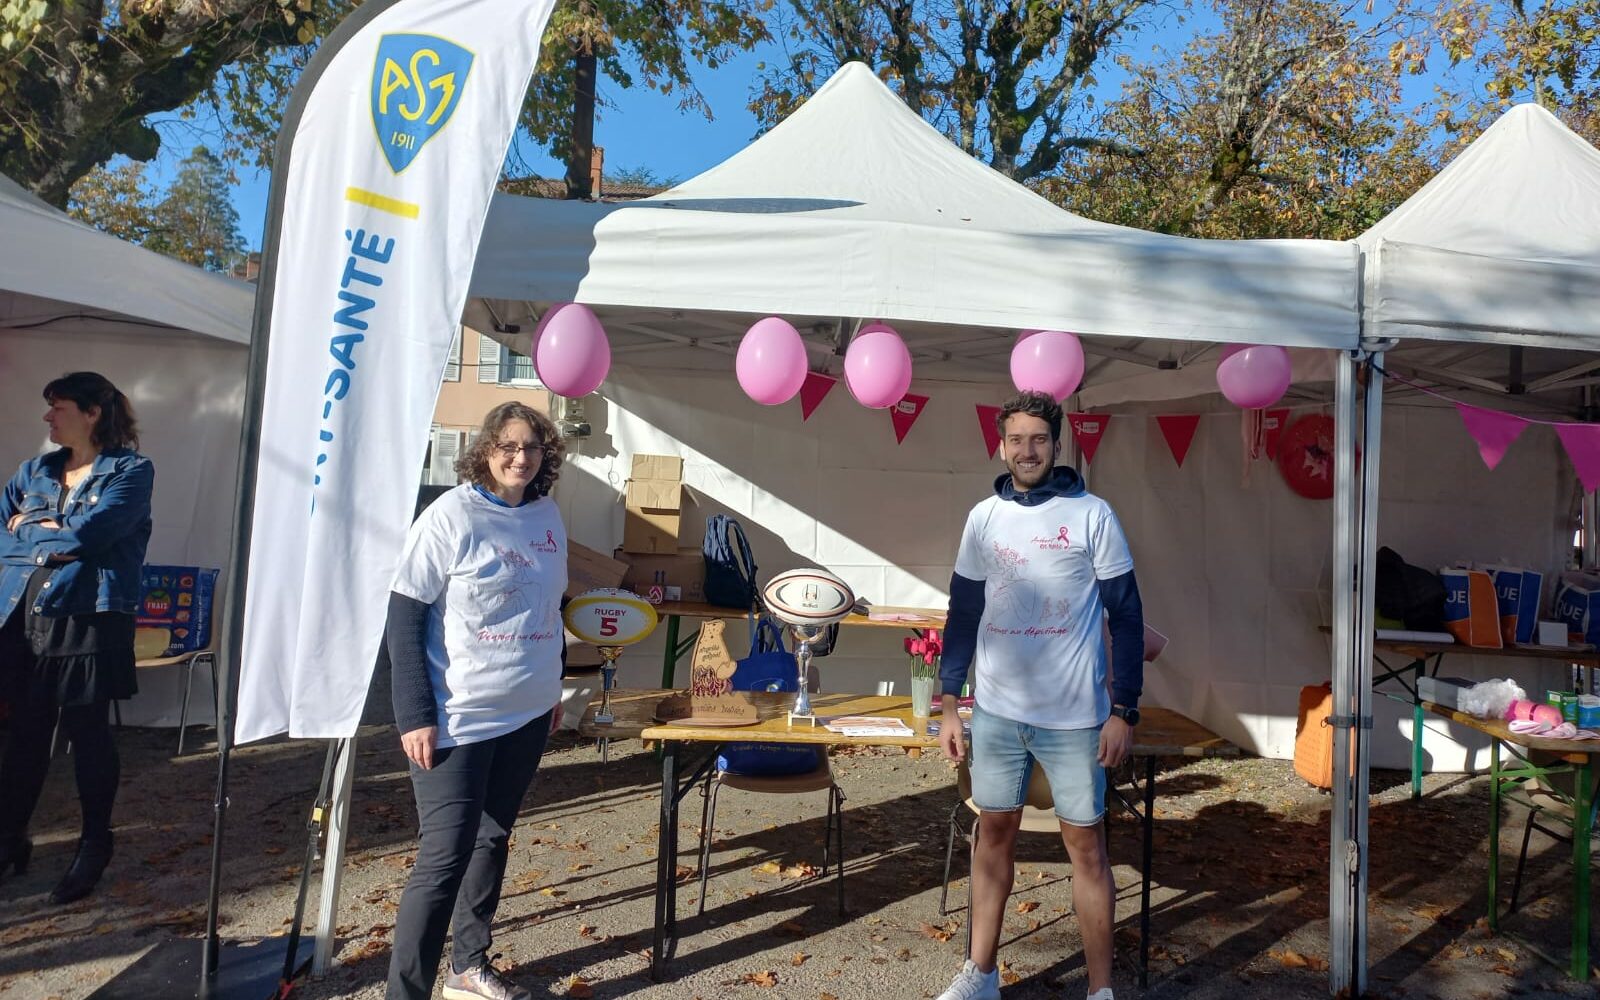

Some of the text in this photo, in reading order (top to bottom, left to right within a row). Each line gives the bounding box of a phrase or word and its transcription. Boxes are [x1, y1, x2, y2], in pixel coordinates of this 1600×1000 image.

[379, 49, 455, 125] ASM
[391, 132, 415, 150] 1911
[594, 608, 627, 617] RUGBY
[600, 617, 618, 636] 5
